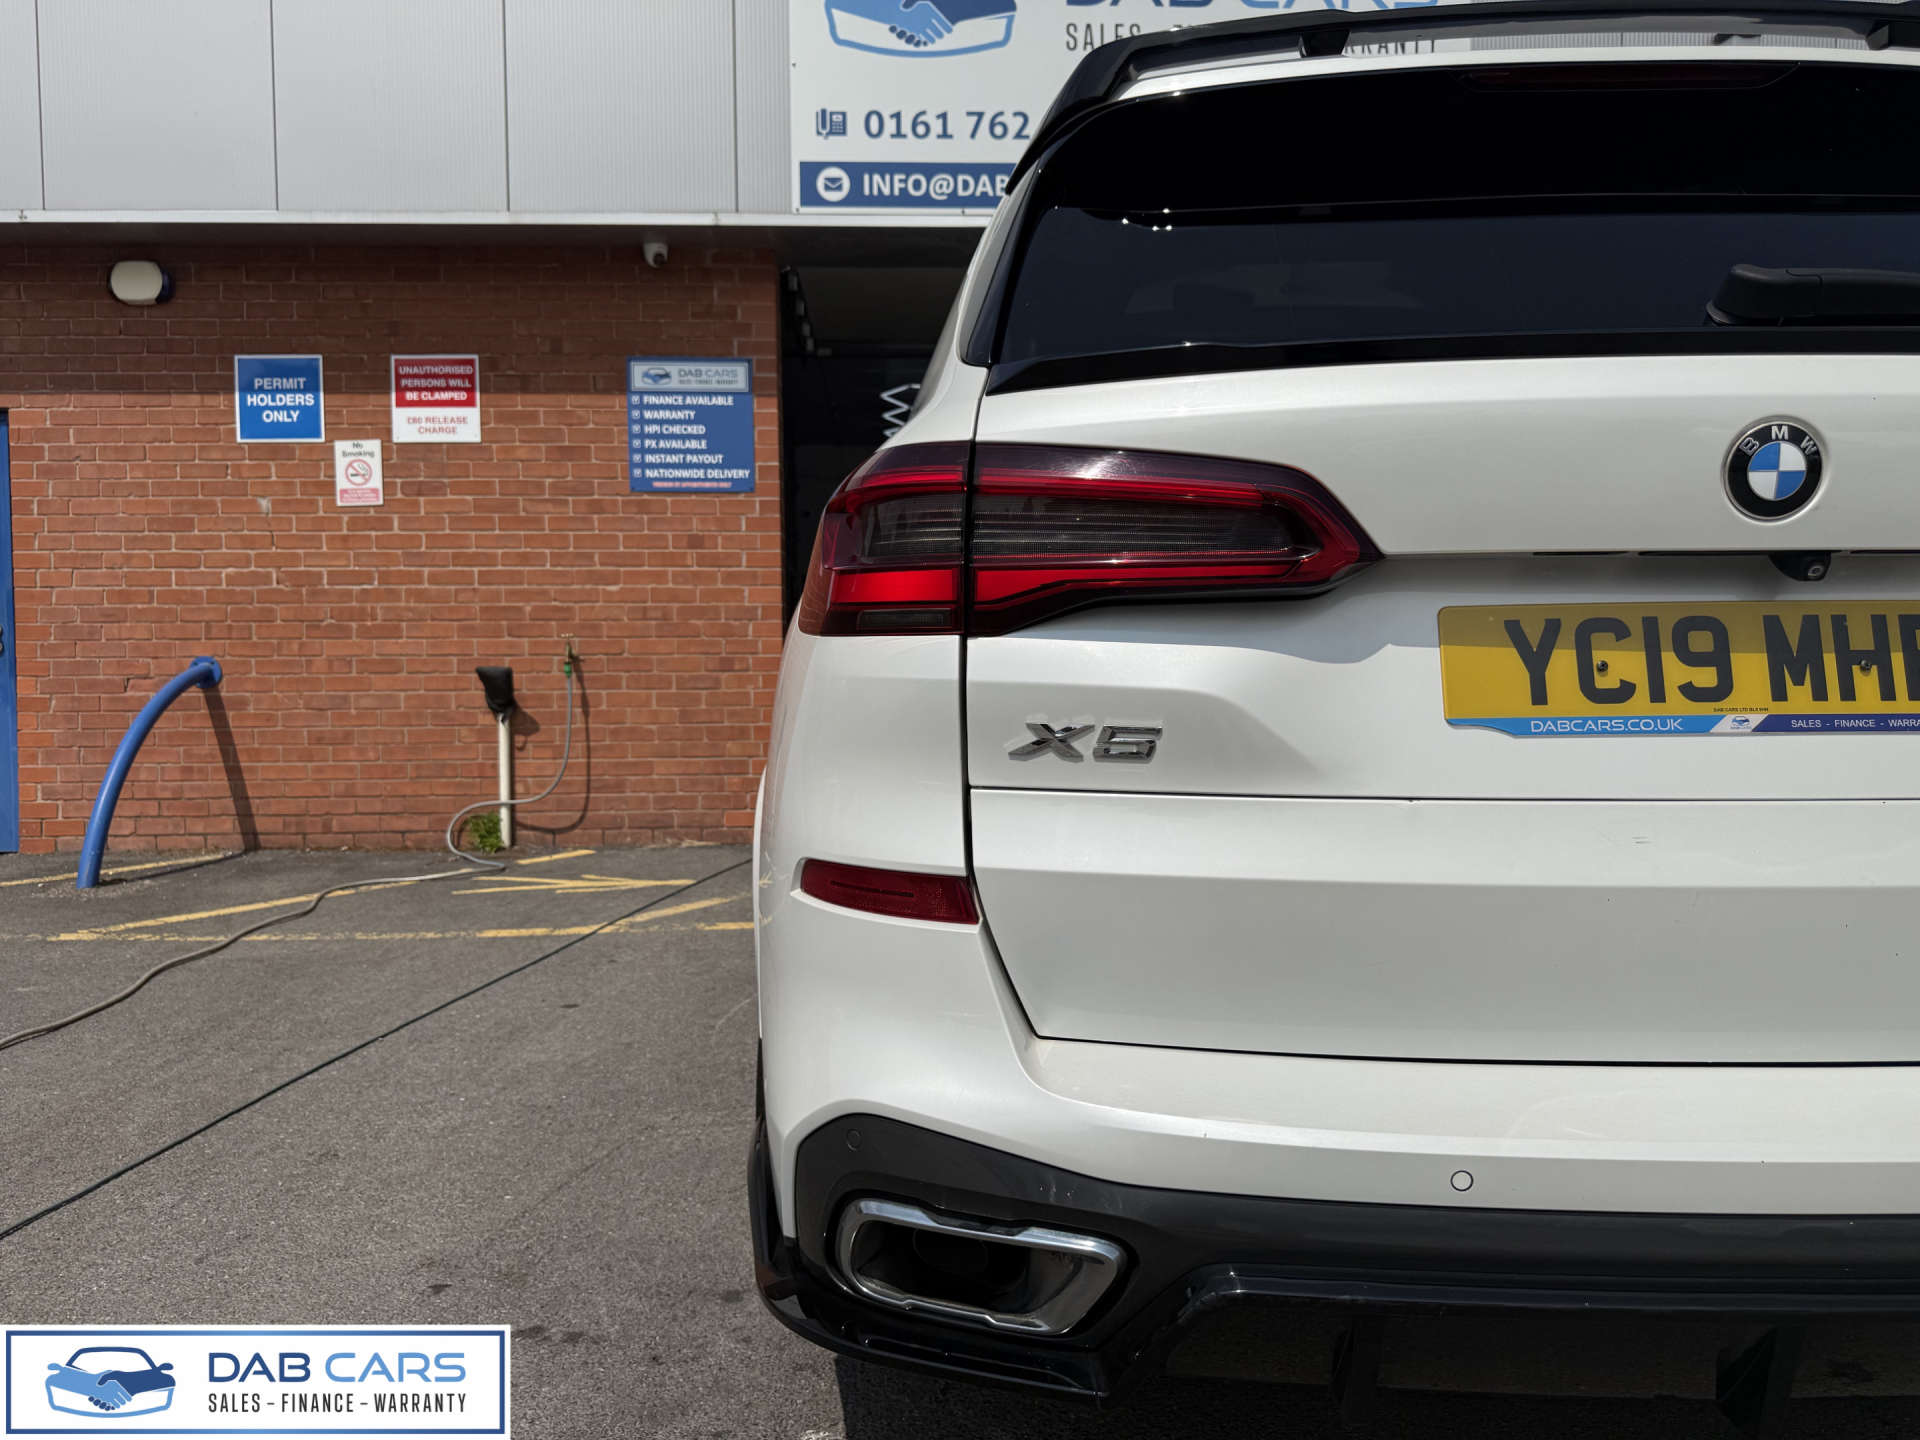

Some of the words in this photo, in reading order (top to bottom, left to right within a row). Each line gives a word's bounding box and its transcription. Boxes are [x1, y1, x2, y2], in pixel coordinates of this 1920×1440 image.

[863, 110, 954, 140] 0161
[965, 111, 1031, 140] 762
[399, 365, 474, 375] UNAUTHORISED
[254, 377, 307, 390] PERMIT
[401, 378, 447, 388] PERSONS
[448, 378, 473, 388] WILL
[247, 393, 315, 406] HOLDERS
[405, 391, 420, 400] BE
[421, 391, 468, 401] CLAMPED
[643, 395, 684, 405] FINANCE
[685, 395, 734, 406] AVAILABLE
[262, 410, 300, 423] ONLY
[424, 416, 468, 424] RELEASE
[643, 410, 696, 420] WARRANTY
[417, 426, 457, 435] CHARGE
[643, 424, 661, 434] HPI
[662, 425, 706, 434] CHECKED
[644, 439, 658, 449] PX
[659, 439, 707, 449] AVAILABLE
[1738, 425, 1818, 457] BMW
[644, 454, 684, 464] INSTANT
[686, 454, 724, 464] PAYOUT
[645, 468, 705, 478] NATIONWIDE
[706, 468, 750, 479] DELIVERY
[1504, 615, 1735, 706] YC19
[1530, 718, 1683, 732] DABCARS.CO.UK
[1791, 719, 1822, 728] SALES
[1834, 719, 1876, 728] FINANCE
